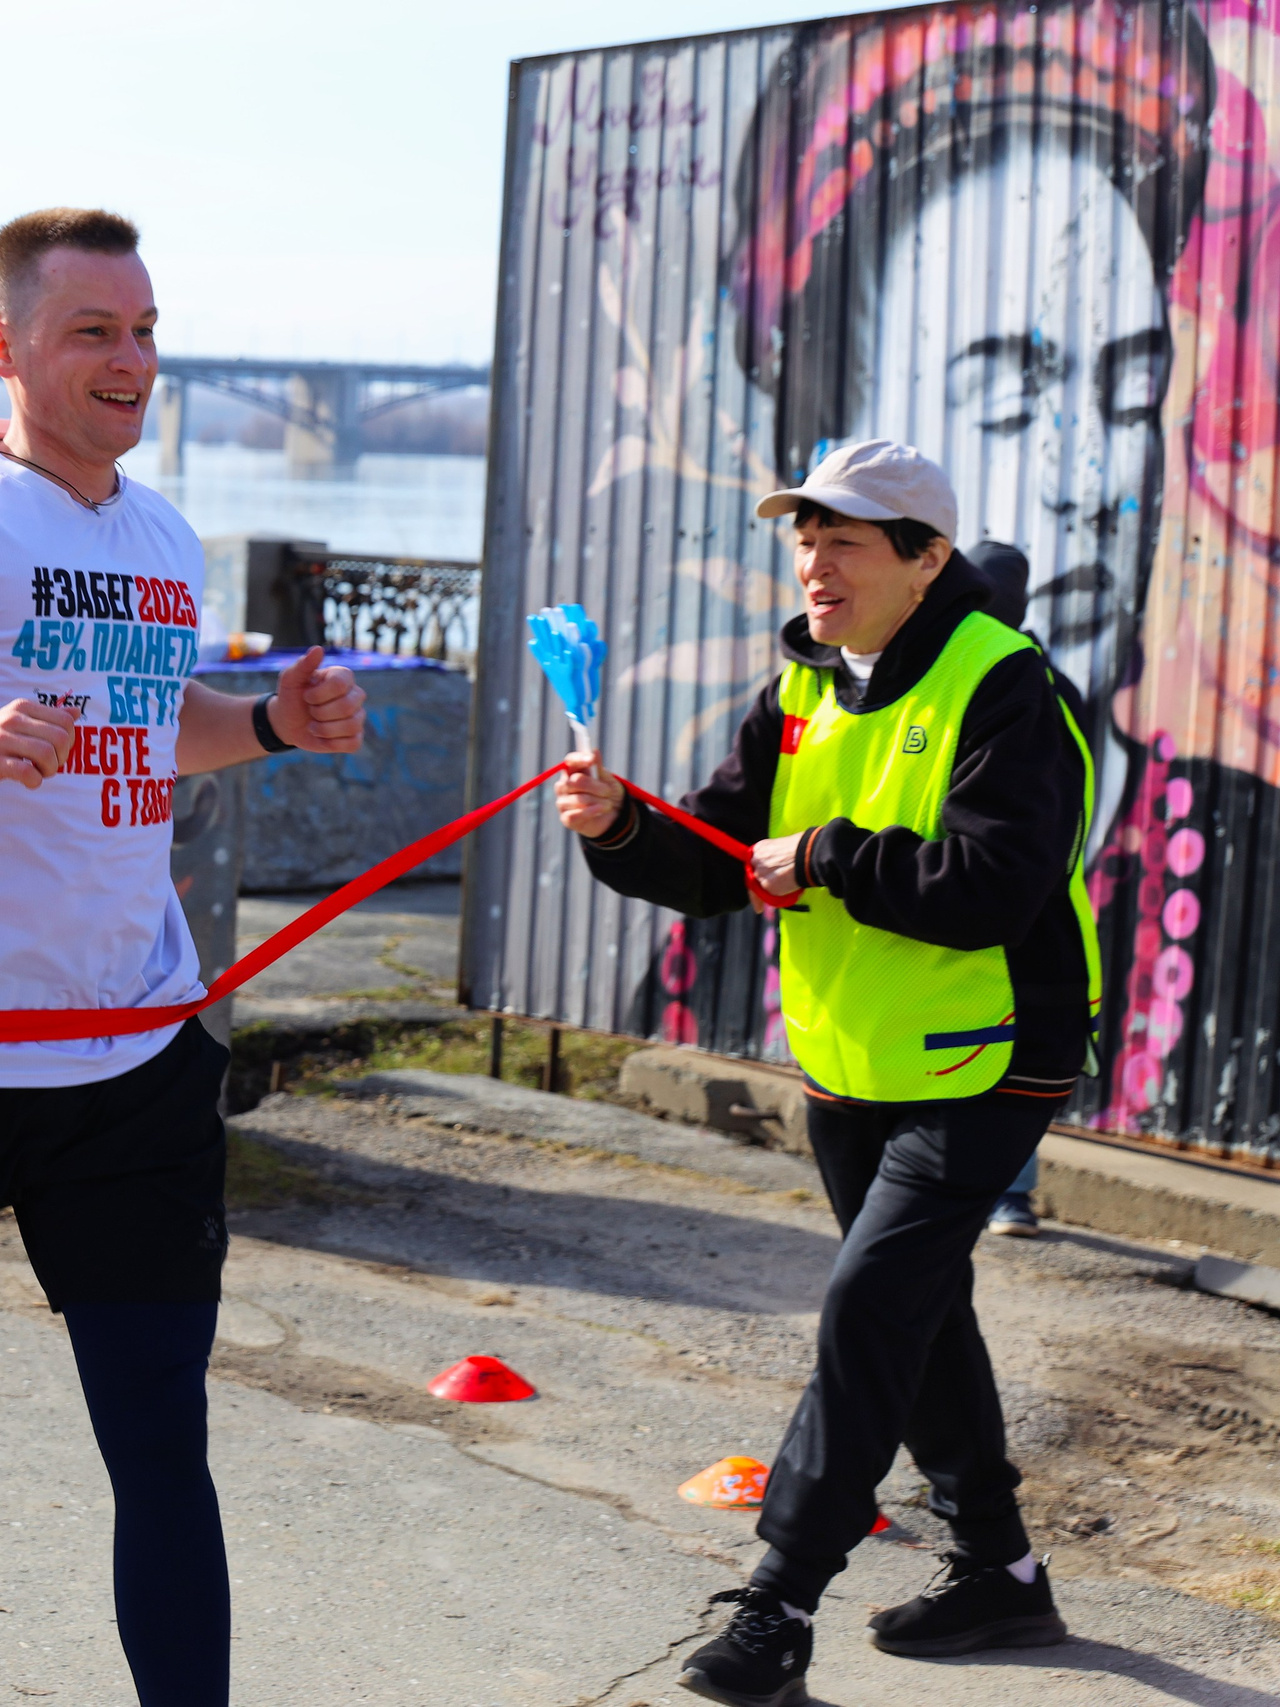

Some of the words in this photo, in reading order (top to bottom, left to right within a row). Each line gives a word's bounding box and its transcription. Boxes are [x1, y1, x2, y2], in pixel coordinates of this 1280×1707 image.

[11, 620, 86, 672] 45%
[107, 676, 180, 726] БЕГУТ
[32, 726, 150, 776] МЕСТЕ
[101, 778, 121, 828] С
